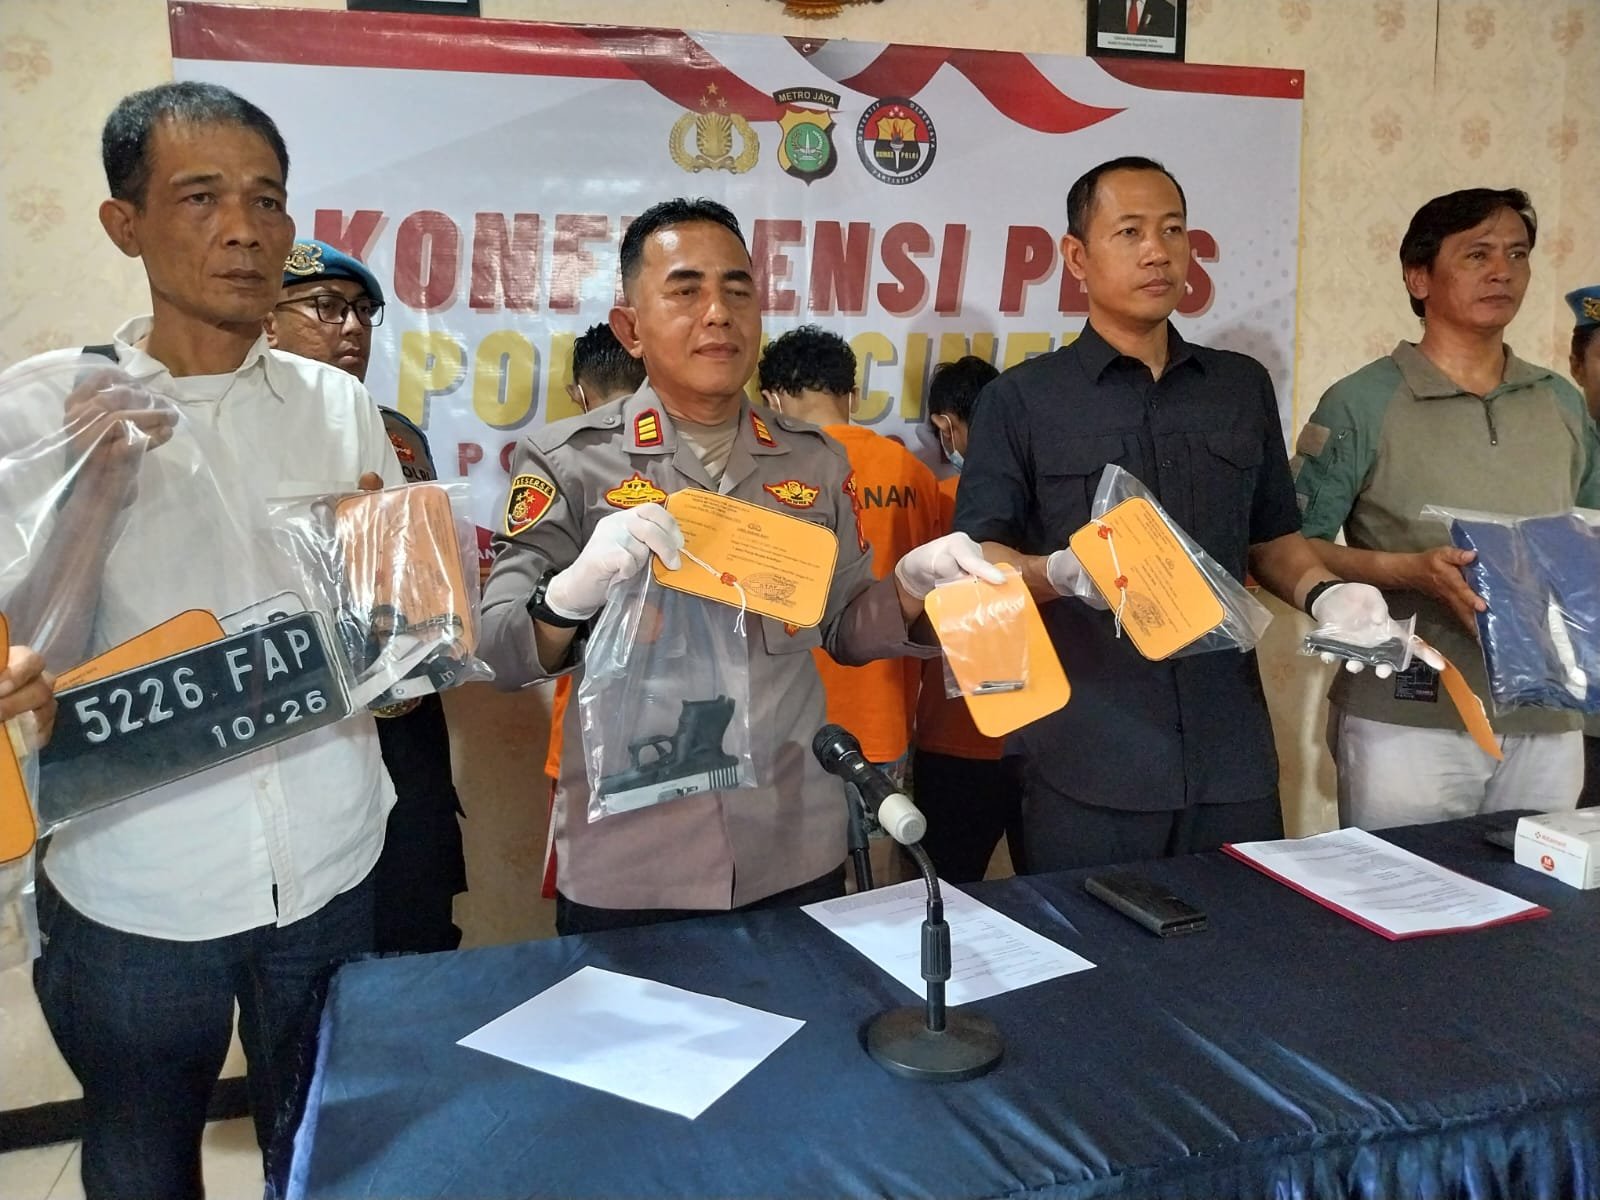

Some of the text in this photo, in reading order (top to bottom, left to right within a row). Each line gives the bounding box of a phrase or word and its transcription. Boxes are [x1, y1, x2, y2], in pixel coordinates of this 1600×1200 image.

[778, 91, 835, 105] METRO JAYA
[901, 151, 919, 160] POLRI
[515, 476, 551, 494] RESERSE
[74, 628, 311, 743] 5226 FAP
